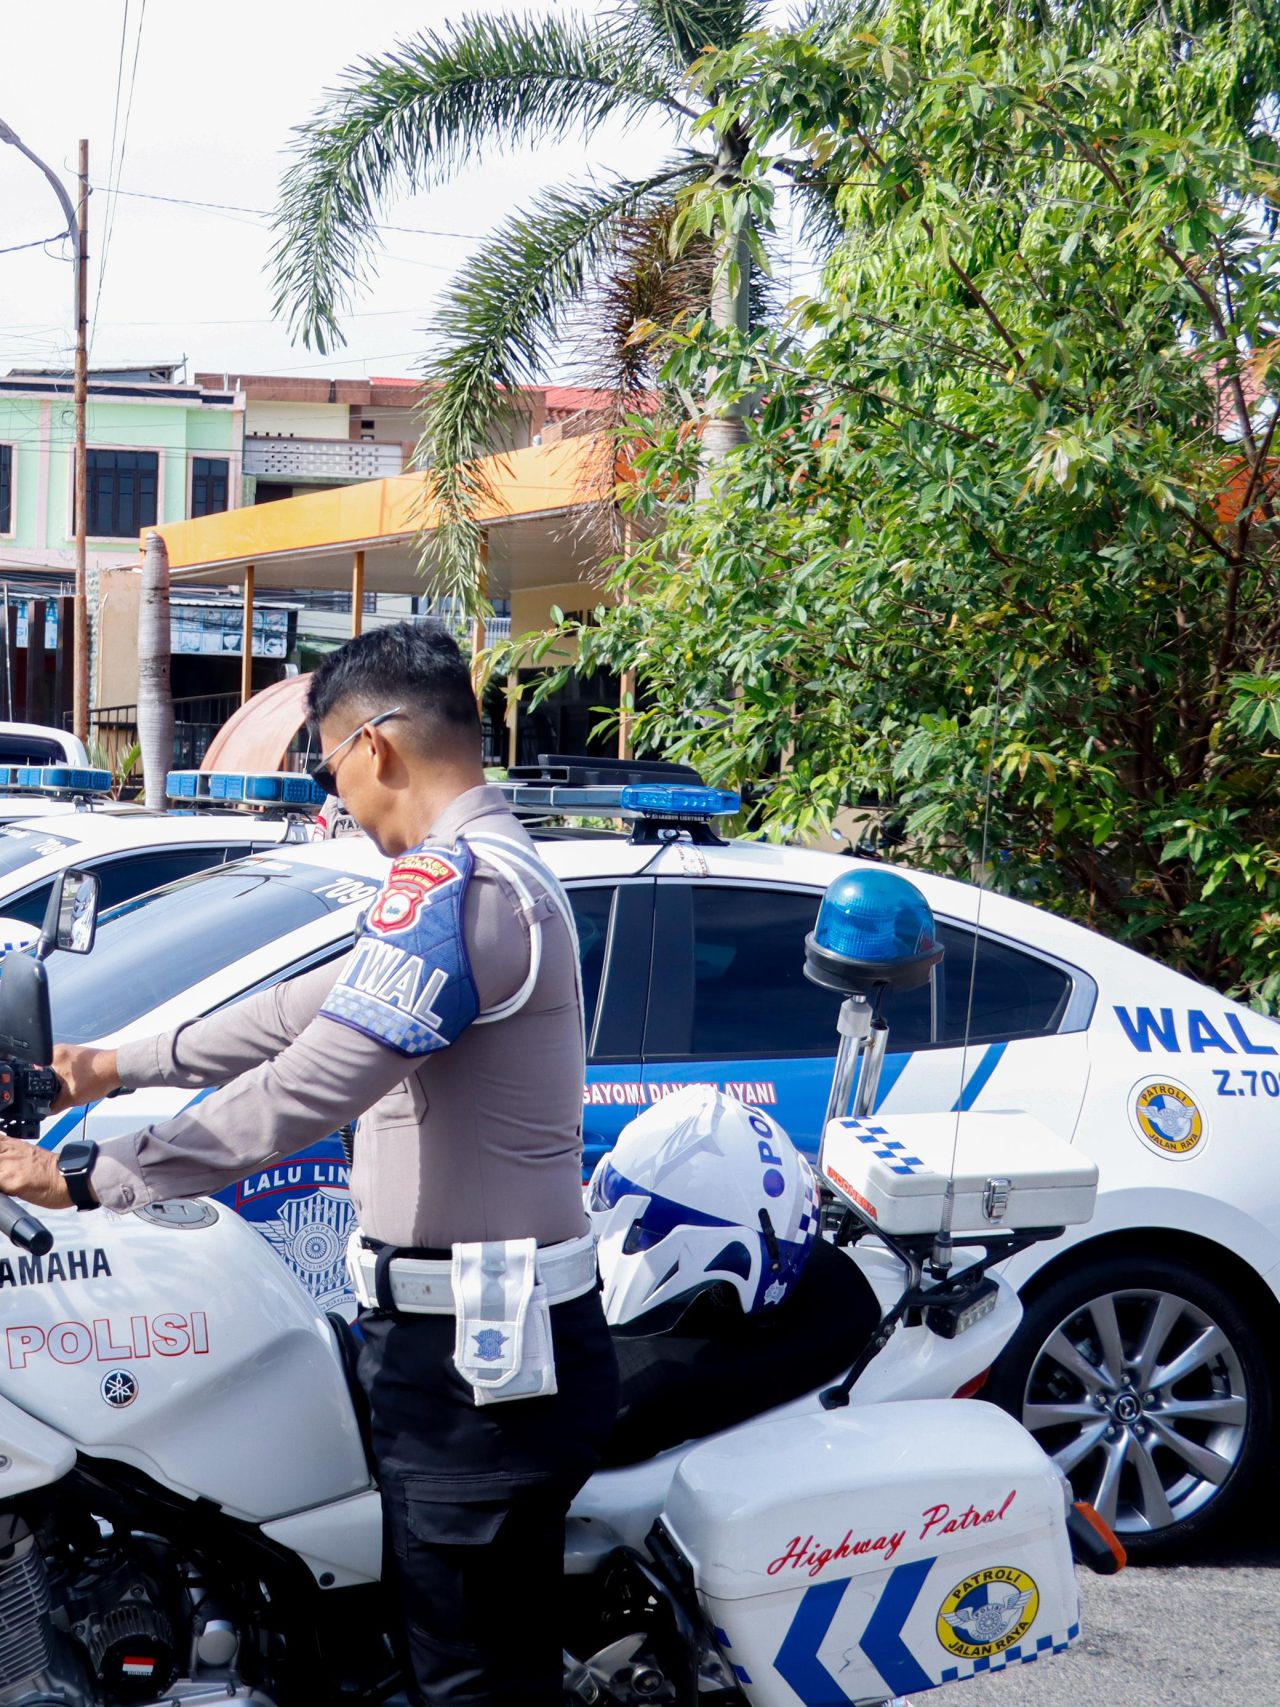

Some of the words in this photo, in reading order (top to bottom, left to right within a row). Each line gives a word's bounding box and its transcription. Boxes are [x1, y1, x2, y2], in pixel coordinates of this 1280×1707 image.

[393, 856, 449, 875] POLRES
[311, 876, 378, 904] 709
[1111, 1005, 1279, 1056] WAL
[1141, 1085, 1188, 1102] PATROLI
[1211, 1069, 1280, 1098] Z.70
[1149, 1132, 1177, 1151] JALAN
[1180, 1132, 1199, 1150] RAYA
[243, 1166, 303, 1198] LALU
[304, 1226, 330, 1235] KORPS
[6, 1311, 210, 1370] POLISI
[767, 1529, 907, 1577] Highway
[919, 1489, 1017, 1540] Patrol
[951, 1568, 1022, 1600] PATROLI
[975, 1604, 1003, 1618] POLISI
[947, 1641, 992, 1657] JALAN
[995, 1621, 1030, 1651] RAYA
